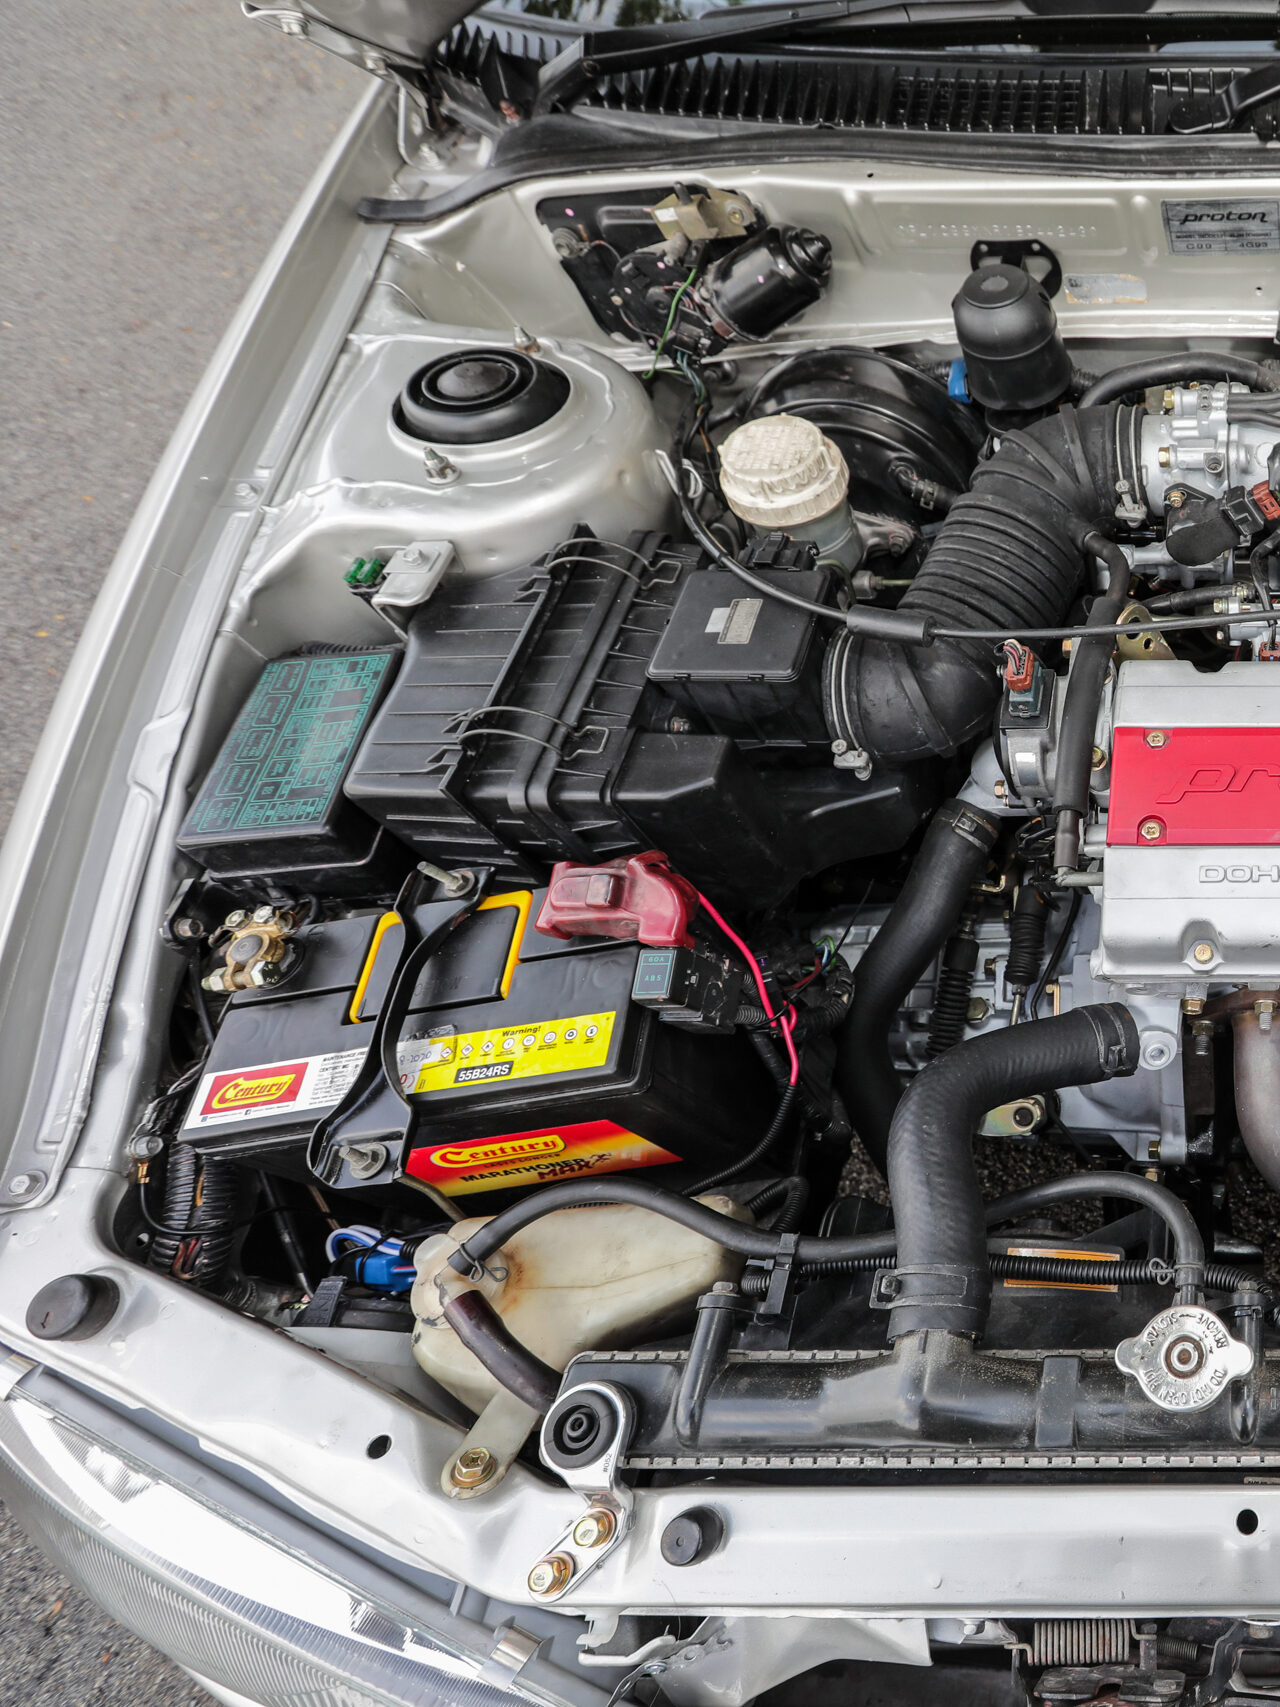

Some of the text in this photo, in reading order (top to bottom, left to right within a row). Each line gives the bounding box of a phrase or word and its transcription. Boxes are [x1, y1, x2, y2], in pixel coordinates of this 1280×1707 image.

[1180, 211, 1268, 225] proton
[502, 1026, 541, 1037] Warning!
[457, 1064, 510, 1082] 55B24RS
[217, 1079, 288, 1105] Century
[441, 1136, 557, 1164] Century
[460, 1158, 585, 1182] MARATHONER
[1196, 1314, 1227, 1349] REMOVE
[1210, 1369, 1225, 1387] DO
[1157, 1386, 1187, 1406] OPEN
[1190, 1384, 1211, 1403] NOT
